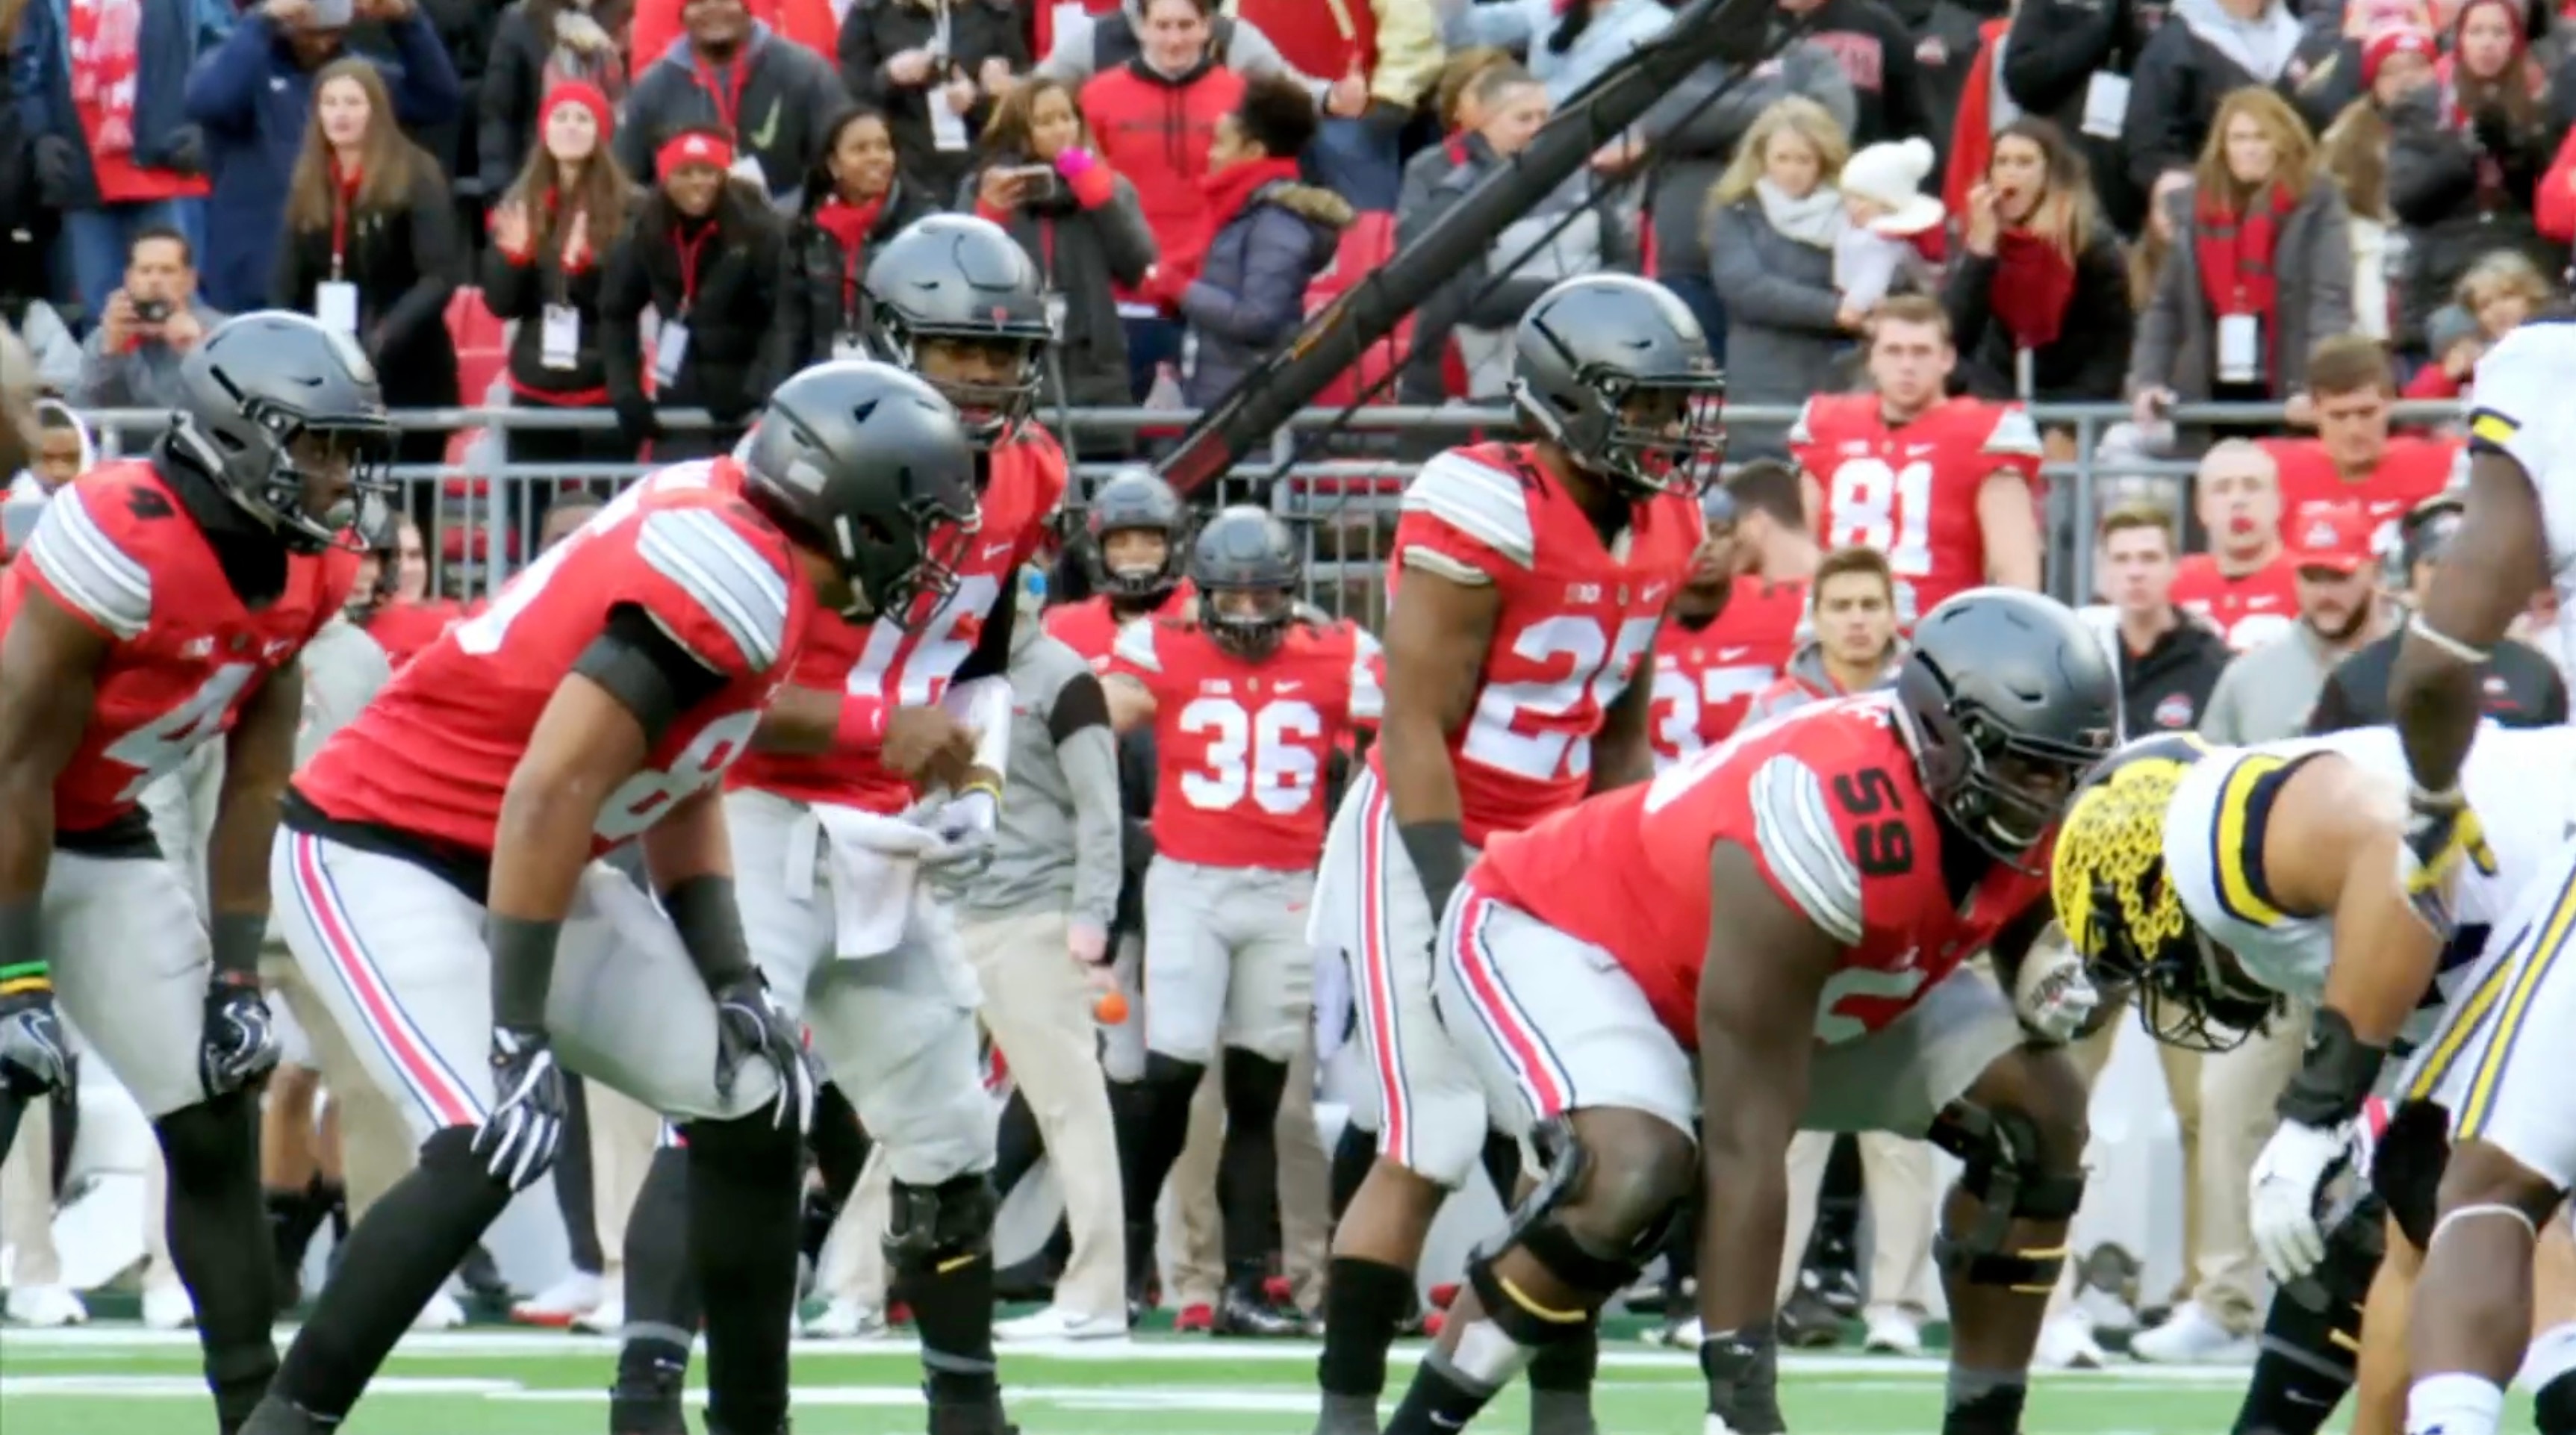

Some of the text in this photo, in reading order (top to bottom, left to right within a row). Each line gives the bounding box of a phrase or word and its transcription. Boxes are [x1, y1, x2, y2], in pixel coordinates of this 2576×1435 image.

[1831, 458, 1932, 576] 81
[102, 662, 256, 801] 4
[1179, 697, 1321, 815] 36
[1834, 767, 1913, 876] 59
